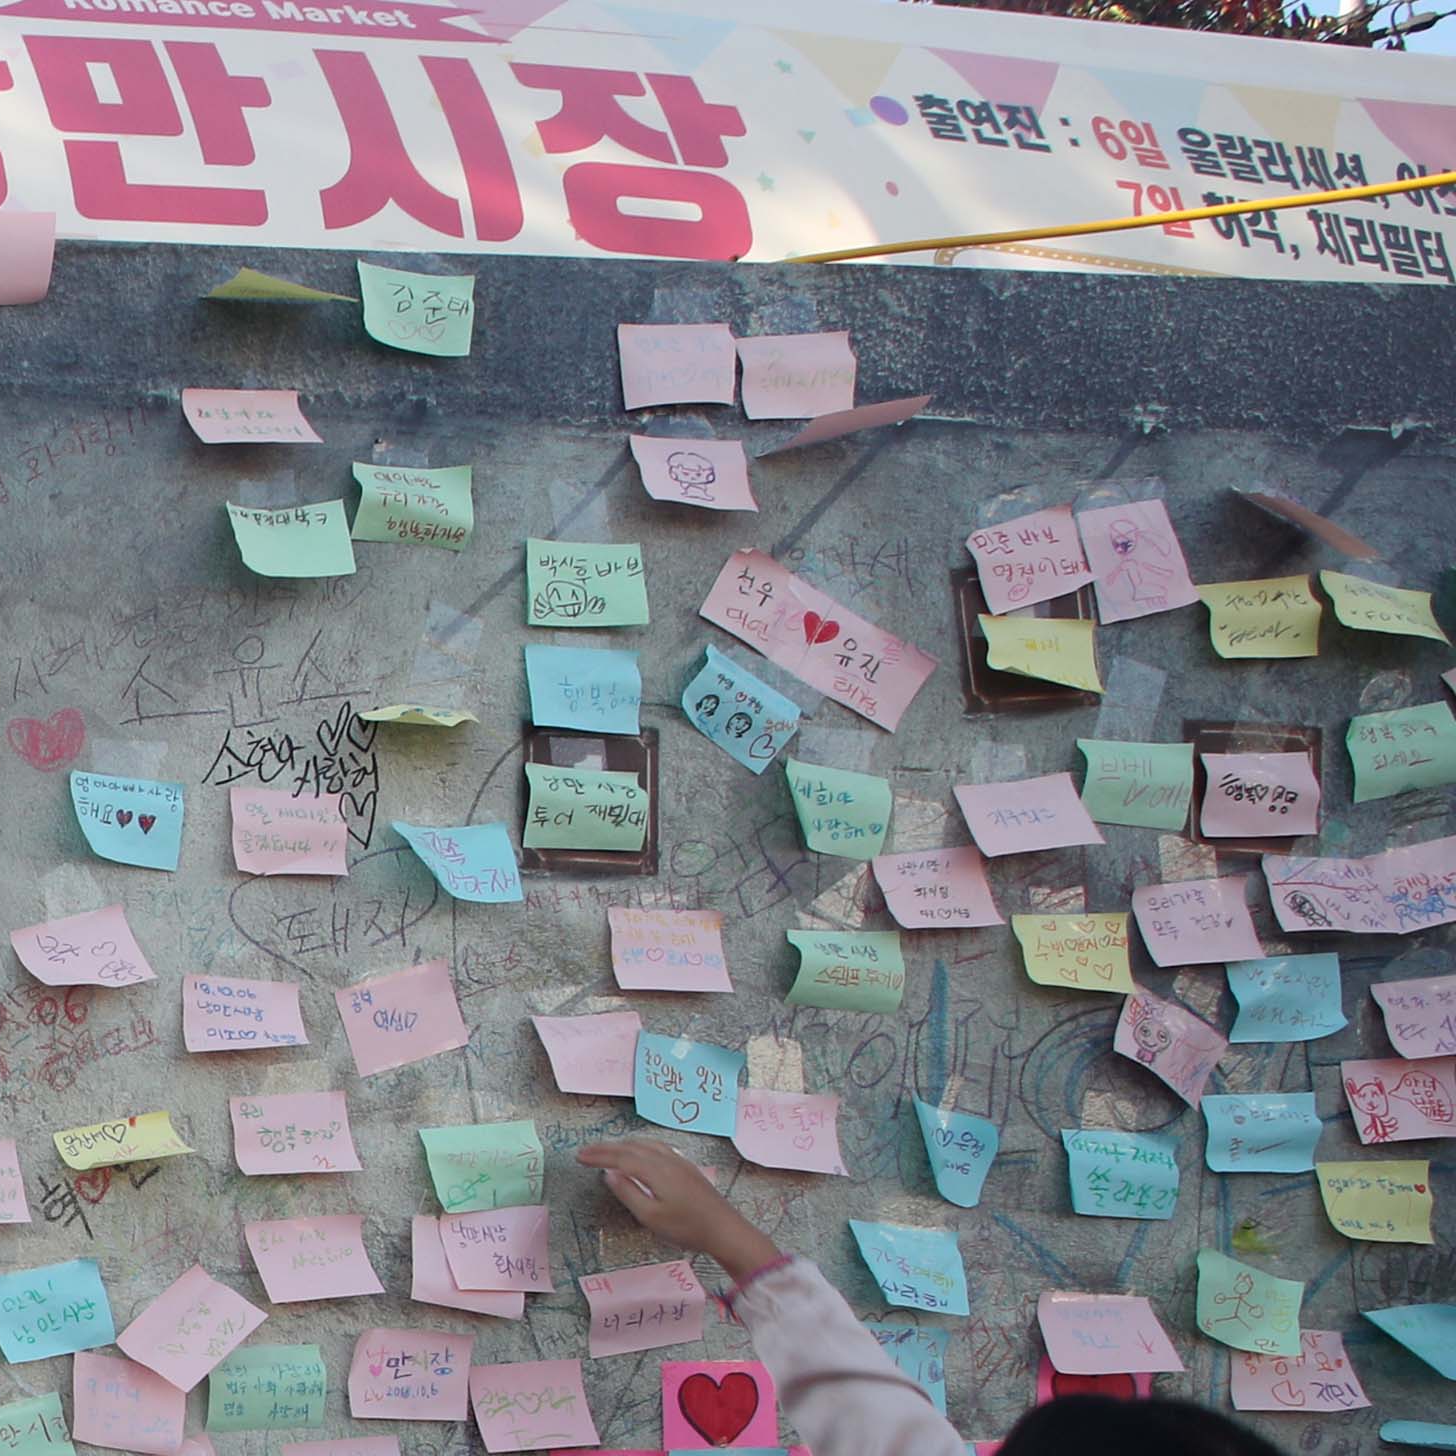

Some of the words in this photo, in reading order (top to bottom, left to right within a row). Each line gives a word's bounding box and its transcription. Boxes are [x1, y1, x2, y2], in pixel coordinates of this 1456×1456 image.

[267, 0, 415, 29] Market
[913, 92, 1053, 154] 출연진
[1091, 115, 1171, 170] 6일
[1115, 180, 1195, 239] 7일
[1306, 208, 1456, 284] 체리필터
[1019, 531, 1060, 547] 바보
[540, 557, 587, 583] 박시후
[597, 560, 642, 576] 바보
[837, 638, 880, 683] 유진
[546, 777, 585, 795] 낭만
[533, 809, 573, 827] 투어
